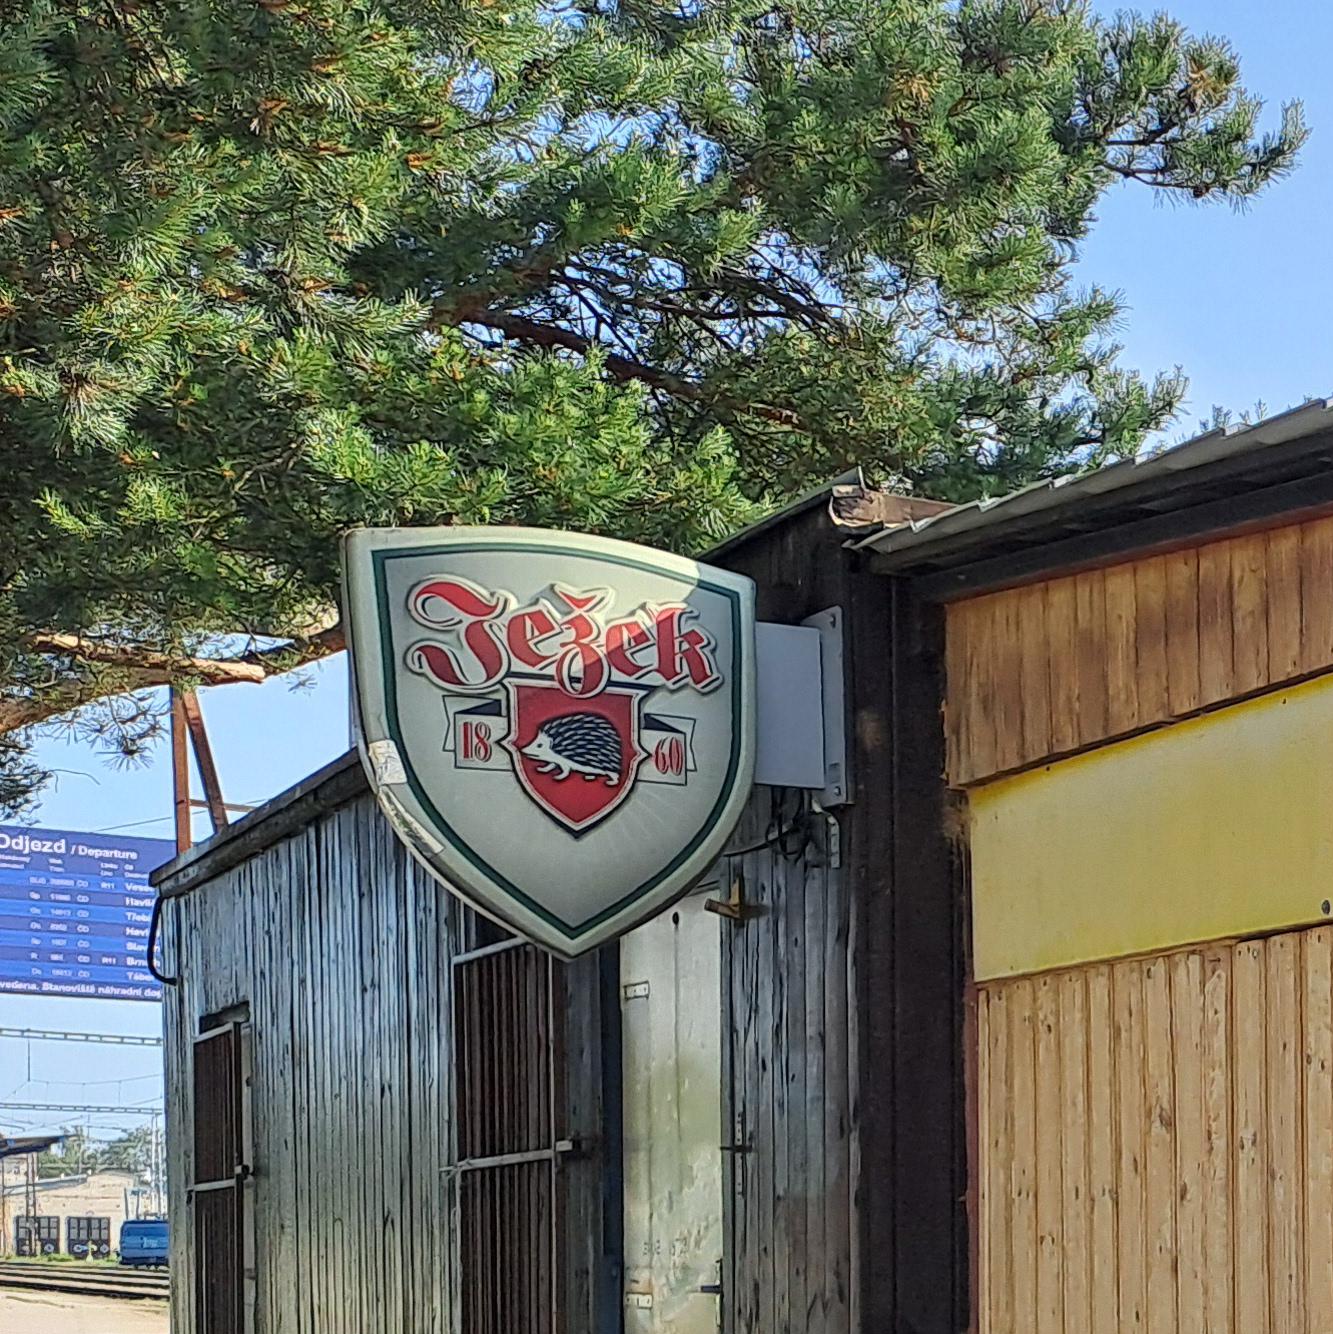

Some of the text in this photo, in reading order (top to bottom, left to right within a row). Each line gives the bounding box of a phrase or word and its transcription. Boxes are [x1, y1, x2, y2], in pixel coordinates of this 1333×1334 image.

[406, 574, 723, 698] Ježek
[462, 721, 684, 776] 18 60
[0, 834, 66, 854] Odjezd
[78, 845, 138, 860] Departure
